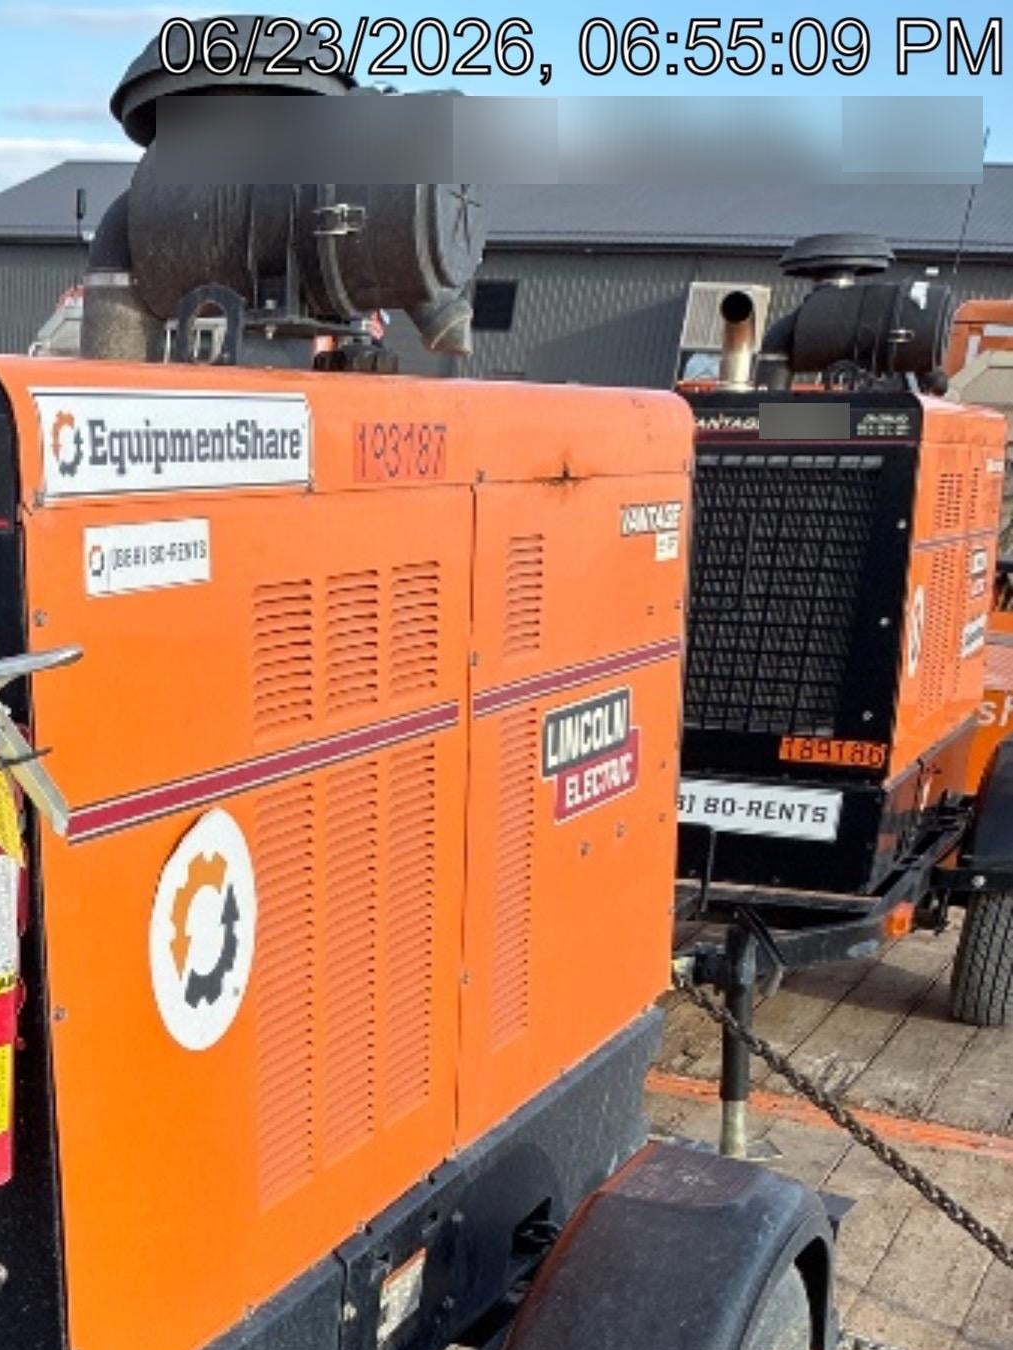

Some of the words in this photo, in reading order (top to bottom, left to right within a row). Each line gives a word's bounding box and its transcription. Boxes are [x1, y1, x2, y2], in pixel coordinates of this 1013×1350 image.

[87, 418, 302, 476] EquipmentShare
[546, 697, 629, 769] LINCOLN
[564, 752, 633, 808] ELECTRIC
[704, 797, 828, 824] 80-RENTS
